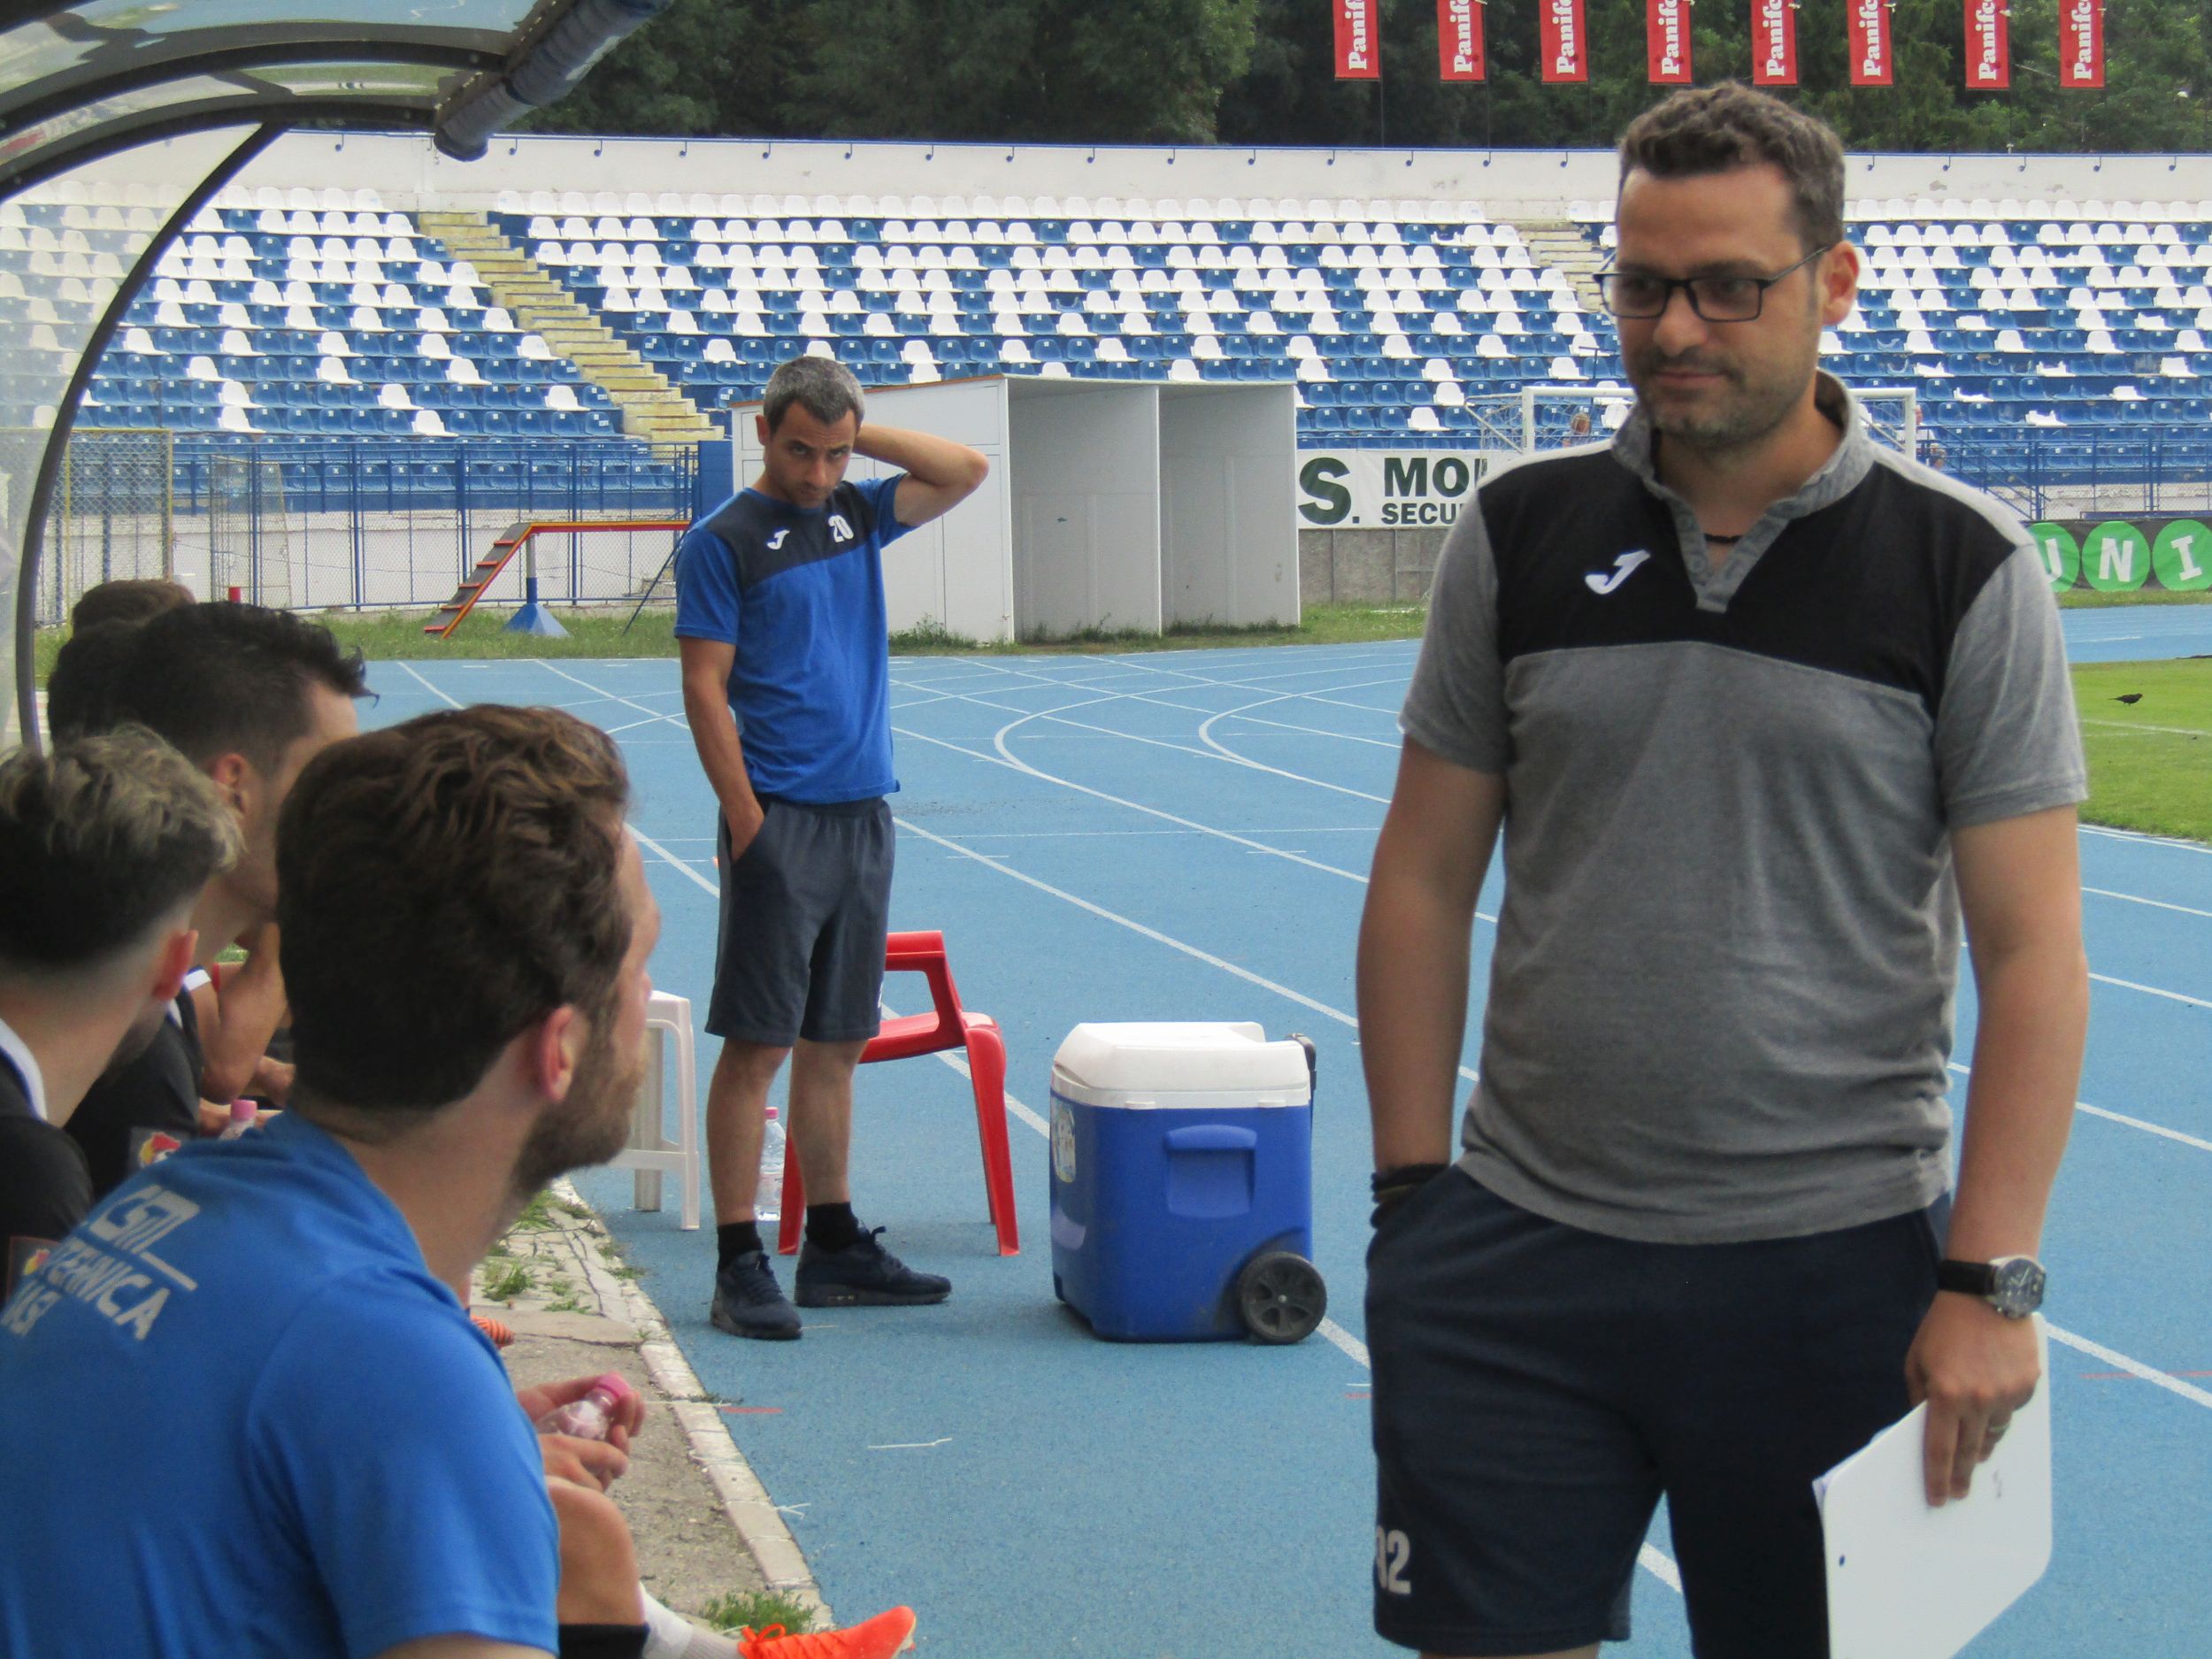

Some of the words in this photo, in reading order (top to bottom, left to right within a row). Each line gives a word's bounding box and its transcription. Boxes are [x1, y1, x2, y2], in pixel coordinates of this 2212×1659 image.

[1974, 0, 1997, 81] Panifc
[2070, 0, 2093, 80] Panifc
[1380, 503, 1464, 525] SECU
